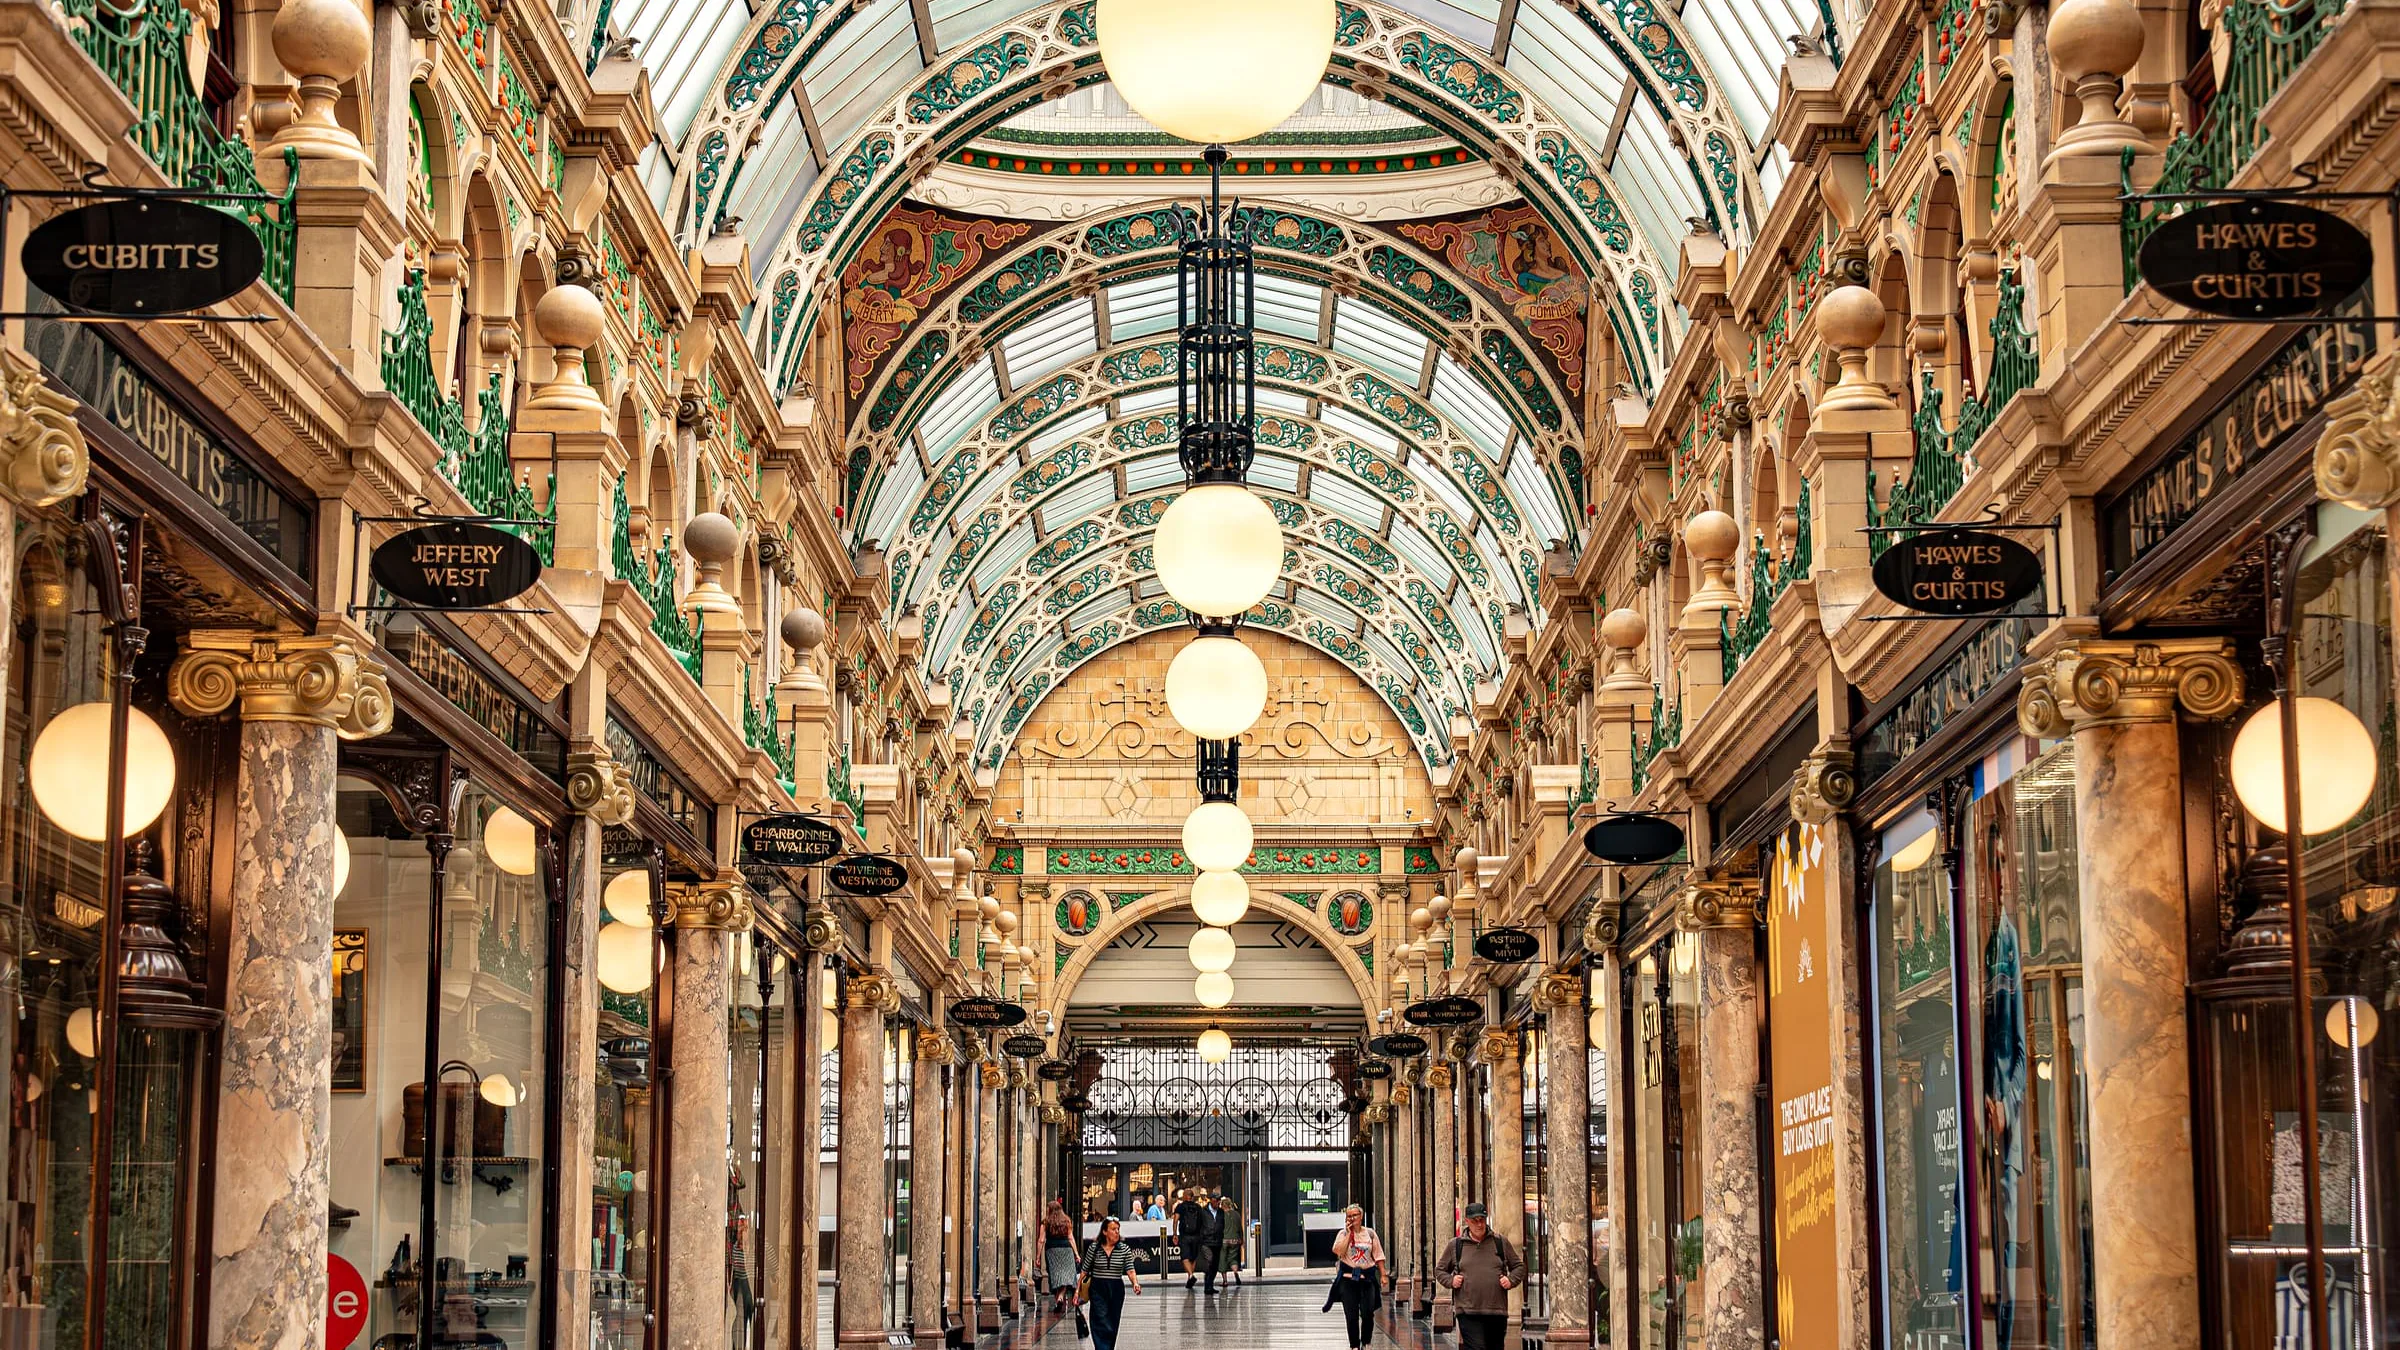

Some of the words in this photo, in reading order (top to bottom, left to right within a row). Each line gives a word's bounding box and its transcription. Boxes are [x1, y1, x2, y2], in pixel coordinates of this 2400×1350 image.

[2196, 223, 2318, 250] HAWES
[62, 244, 220, 270] CUBITTS
[2247, 250, 2267, 271] &
[2192, 272, 2322, 299] CURTIS
[855, 303, 895, 322] LIBERTY
[2225, 416, 2243, 475] &
[2253, 300, 2366, 449] CURTIS
[113, 366, 226, 506] CUBITTS
[411, 544, 504, 564] JEFFERY
[1914, 545, 2002, 565] HAWES
[422, 567, 491, 587] WEST
[1951, 565, 1965, 580] &
[1911, 580, 2006, 600] CURTIS
[750, 826, 836, 842] CHARBONNEL
[754, 840, 771, 852] ET
[775, 841, 830, 855] WALKER
[846, 865, 894, 876] VIVIENNE
[838, 875, 900, 887] WESTWOOD
[1488, 935, 1527, 944] ASTRID
[1495, 949, 1521, 958] MIYU
[954, 1011, 1000, 1020] WESTWOOD
[960, 1004, 996, 1012] VIVIENNE
[1640, 999, 1662, 1043] ASTRI
[1781, 1099, 1794, 1128] THE
[1793, 1093, 1808, 1124] ONLY
[1809, 1085, 1830, 1118] PLACE
[1783, 1128, 1795, 1156] BUY
[1795, 1121, 1813, 1153] LOUIS
[1813, 1116, 1834, 1147] VUITT
